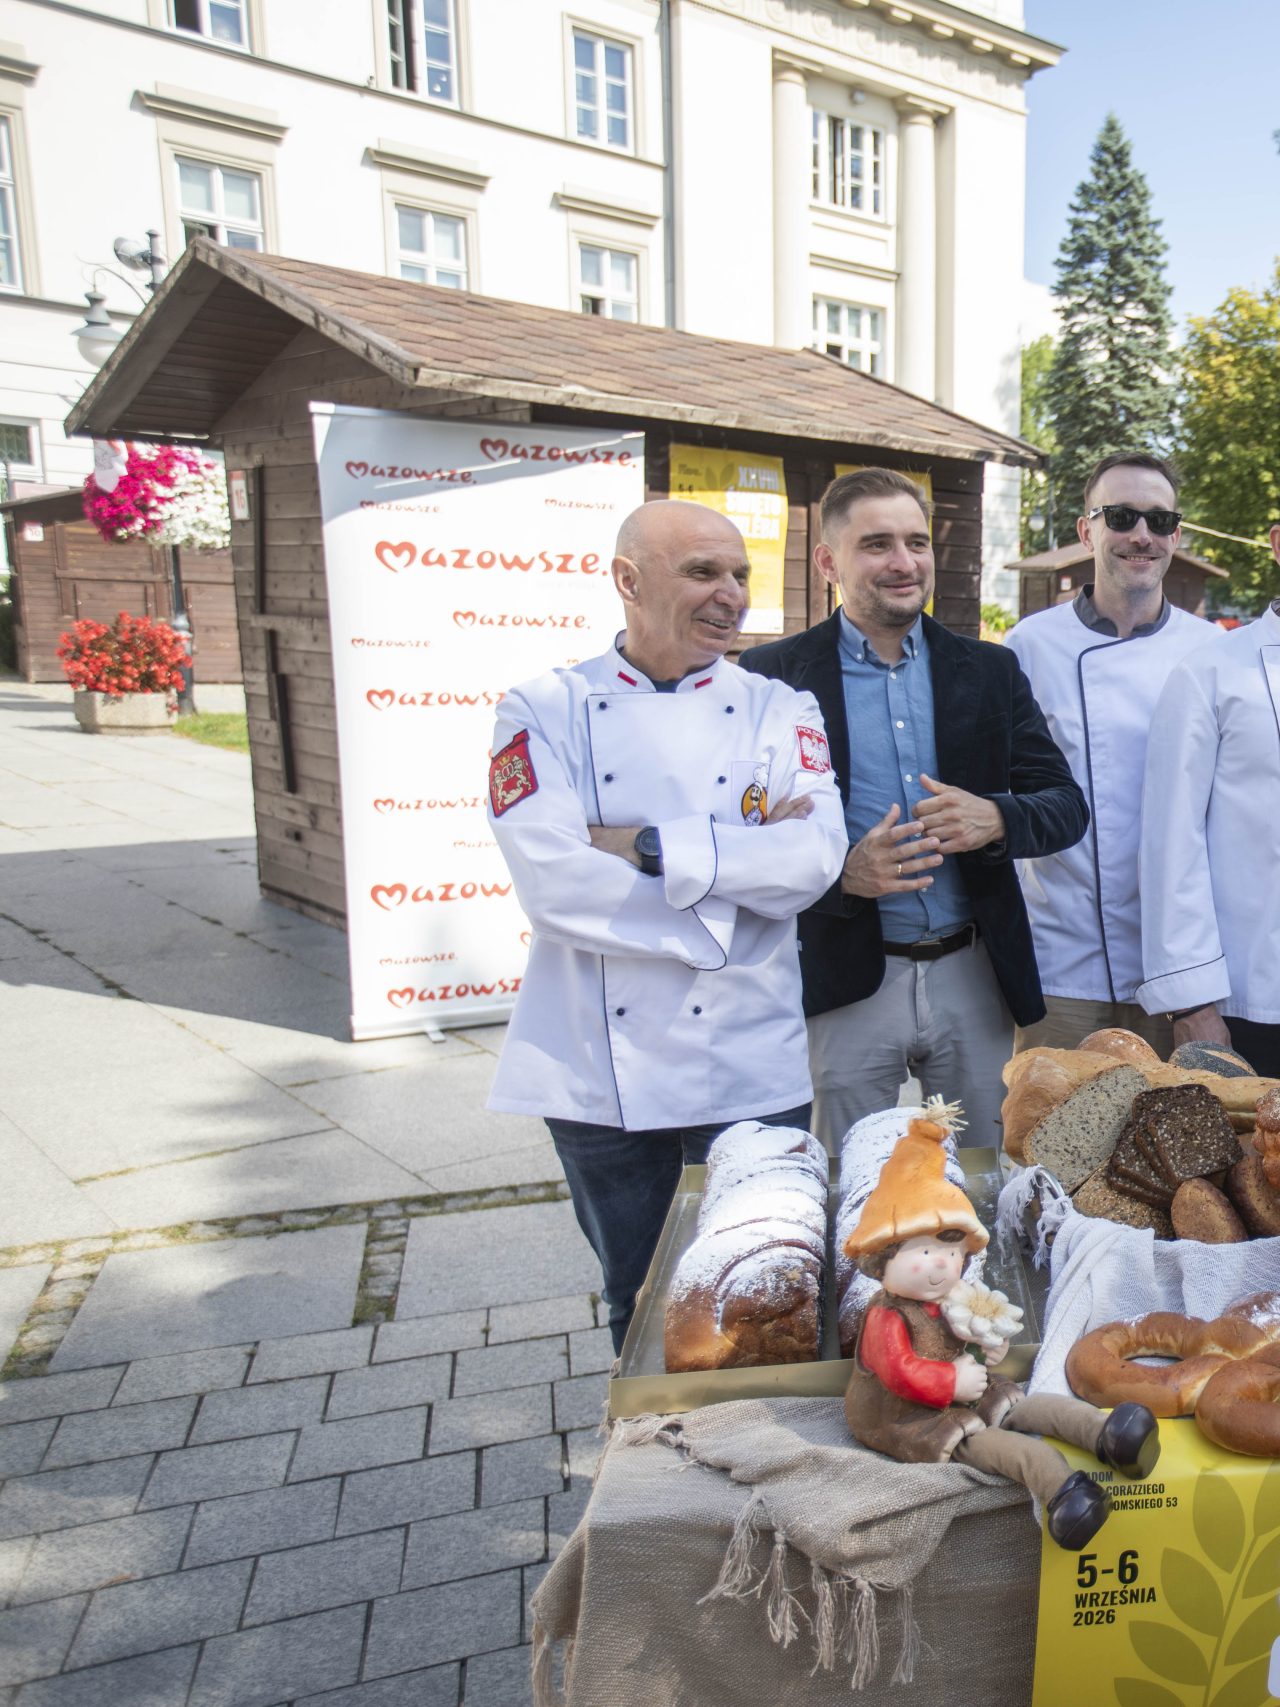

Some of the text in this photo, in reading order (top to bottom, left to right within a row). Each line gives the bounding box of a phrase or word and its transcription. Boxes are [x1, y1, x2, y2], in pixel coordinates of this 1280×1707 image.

[480, 438, 637, 469] Mazowsze.
[345, 461, 477, 485] Mazowsze.
[375, 540, 608, 577] Mazowsze.
[452, 610, 591, 630] Mazowsze.
[366, 689, 506, 711] Mazowsz
[370, 882, 512, 911] Mazow
[387, 977, 523, 1008] Mazowsz
[1086, 1471, 1114, 1483] ADOM
[1106, 1483, 1166, 1497] CORAZZIEGO
[1112, 1497, 1178, 1511] OMSKIEGO 53
[1076, 1549, 1140, 1588] 5-6
[1073, 1584, 1157, 1610] WRZEŚNIA
[1072, 1608, 1116, 1627] 2026
